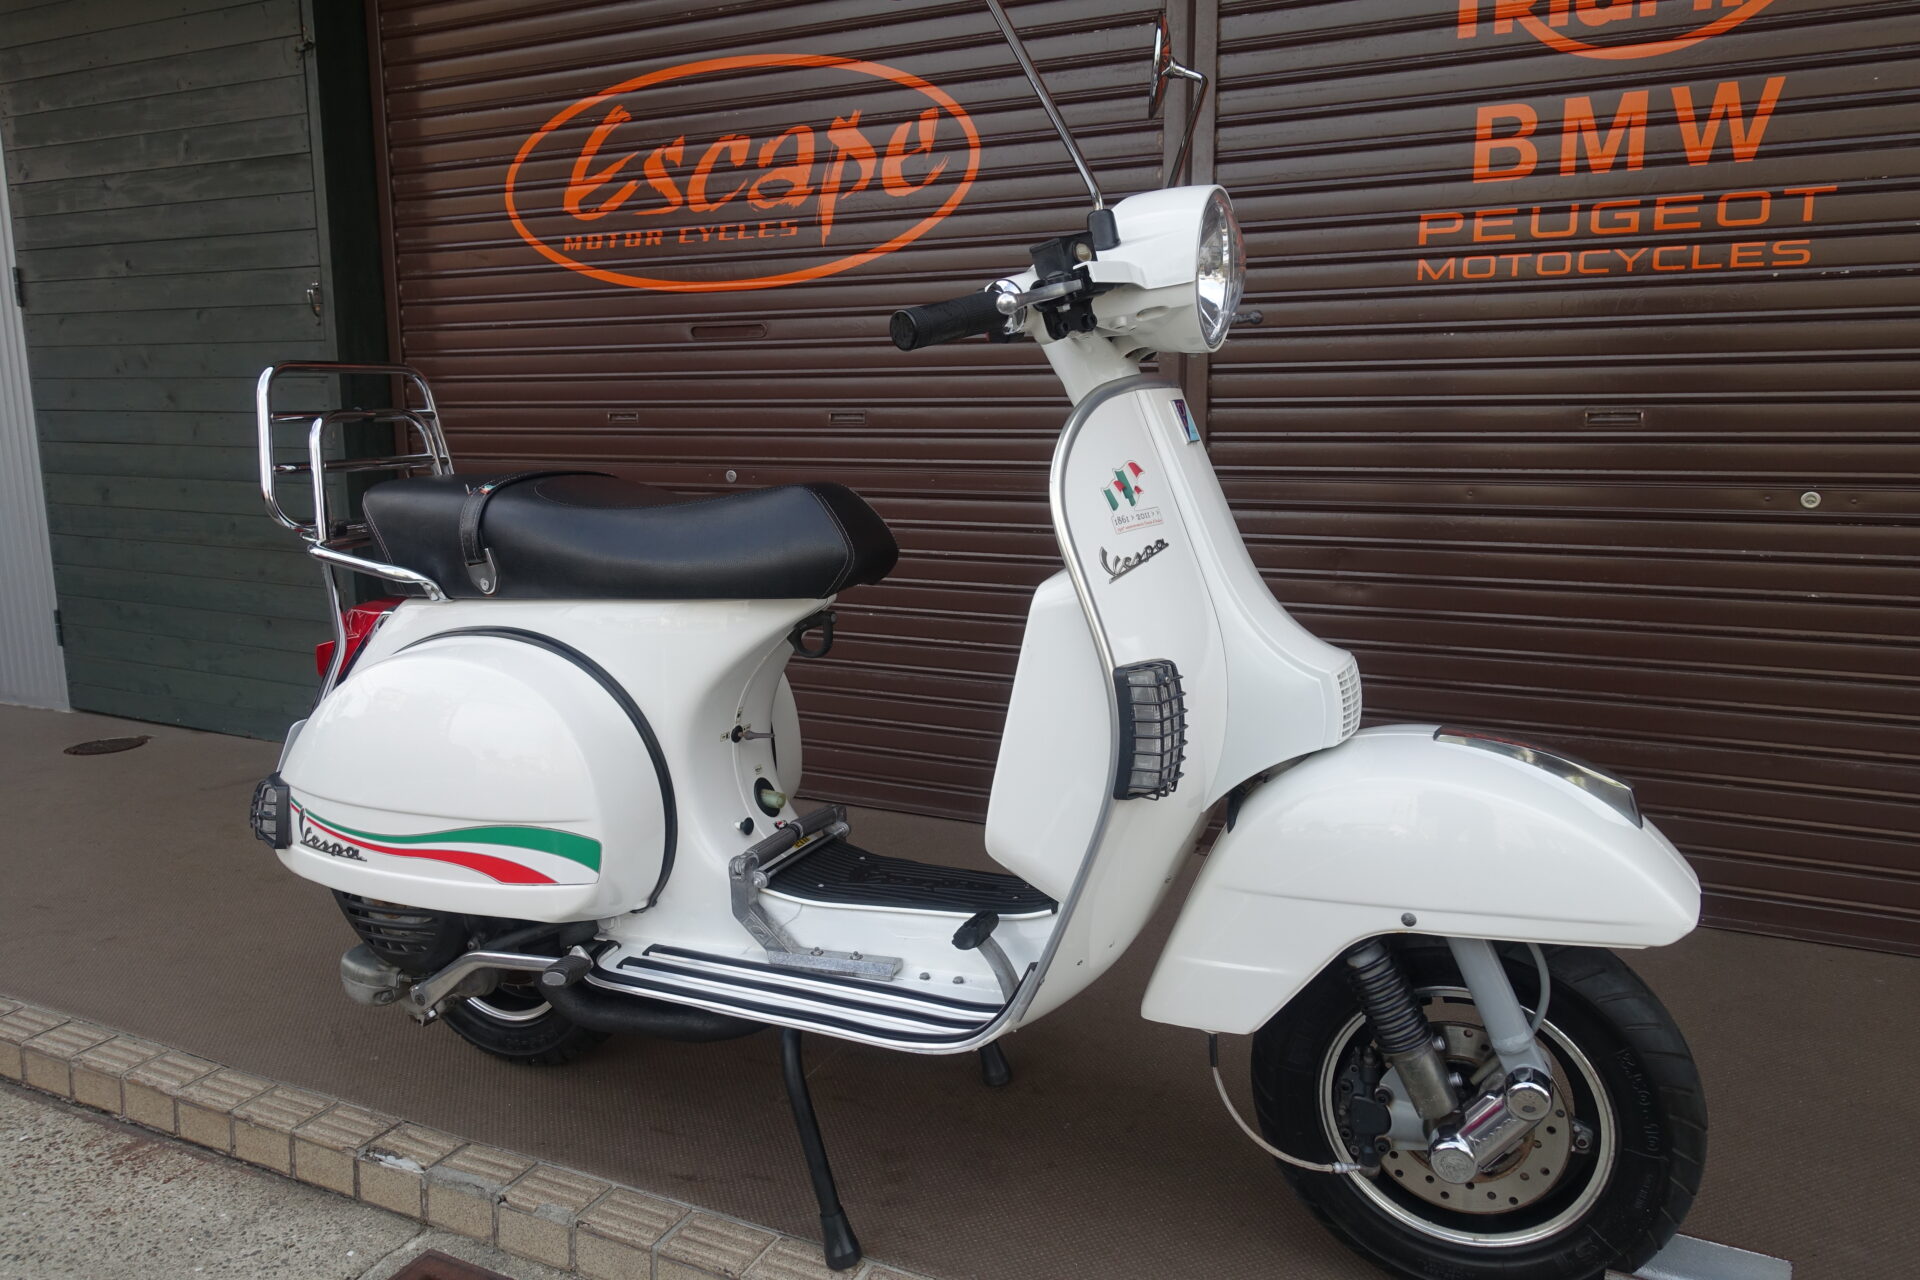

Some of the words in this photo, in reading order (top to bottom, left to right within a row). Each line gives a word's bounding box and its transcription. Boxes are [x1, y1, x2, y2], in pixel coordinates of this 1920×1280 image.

[1473, 76, 1786, 183] BMW
[563, 104, 950, 248] Escape
[563, 229, 663, 251] MOTOR
[678, 219, 799, 244] CYCLES
[1417, 185, 1838, 246] PEUGEOT
[1416, 239, 1812, 281] MOTOCYCLES
[1114, 514, 1130, 525] 1861
[1136, 511, 1152, 521] 2011
[1100, 538, 1169, 584] Vespa
[299, 808, 367, 862] Vespa
